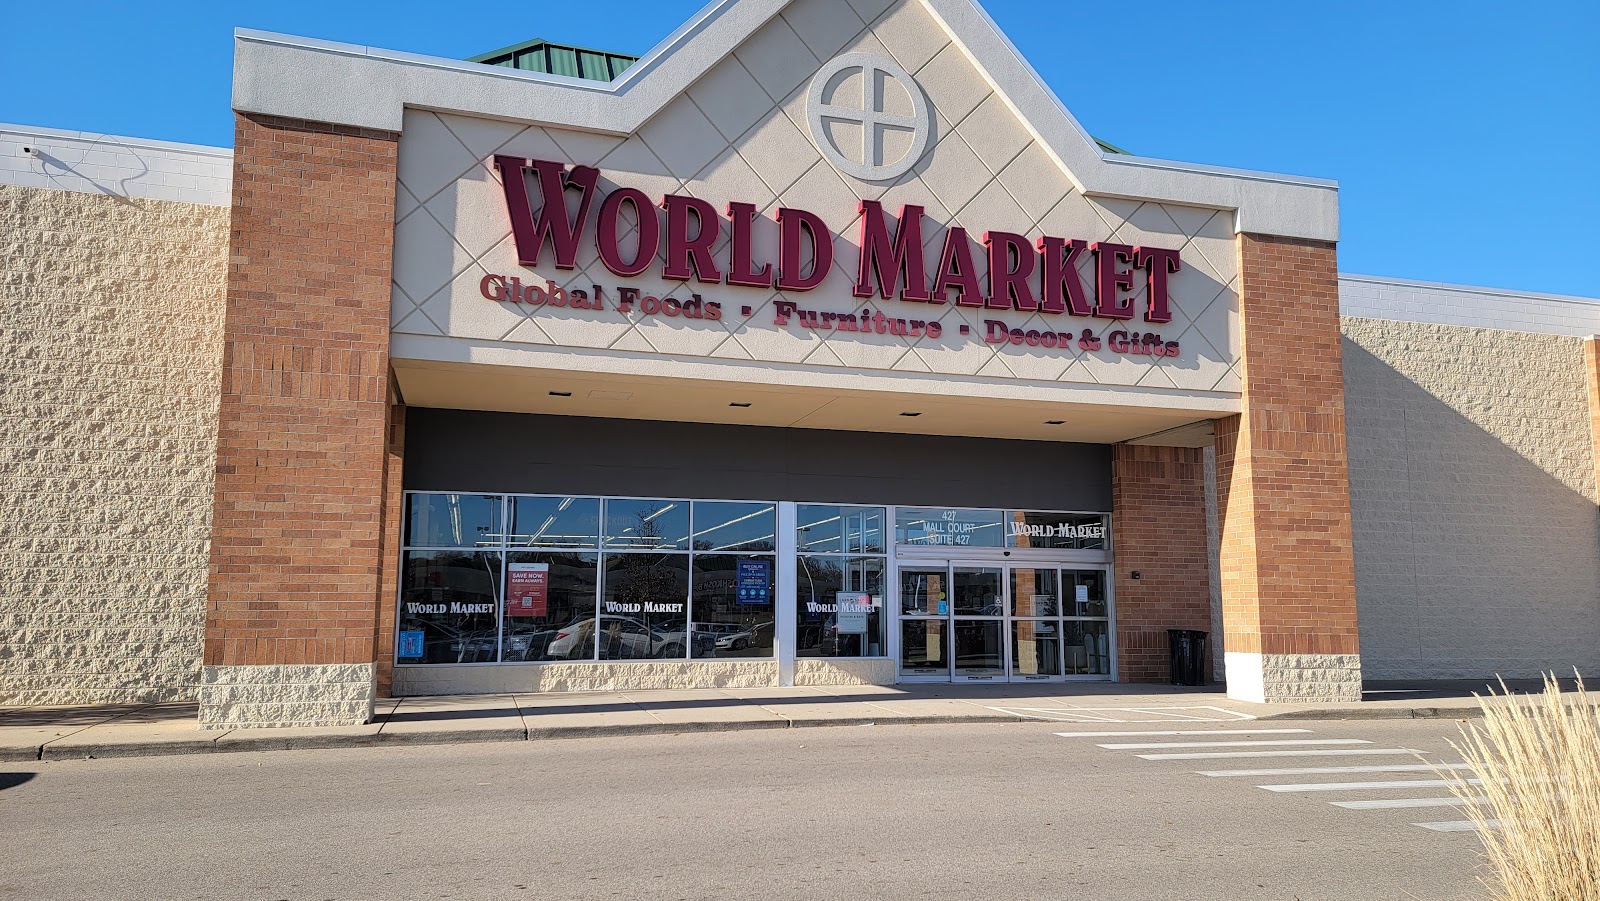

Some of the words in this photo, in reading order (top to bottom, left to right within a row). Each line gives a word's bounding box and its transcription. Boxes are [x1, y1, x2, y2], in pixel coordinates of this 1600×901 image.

[494, 154, 834, 292] WORLD
[853, 200, 1181, 323] MARKET
[479, 273, 604, 311] Global
[616, 286, 722, 321] Foods
[773, 300, 943, 339] Furniture
[984, 318, 1073, 351] Decor
[1078, 328, 1101, 352] &
[1109, 329, 1180, 358] Gifts
[941, 510, 957, 521] 427
[923, 521, 944, 533] MALL
[948, 522, 976, 534] COURT
[1010, 521, 1054, 537] WORLD
[1058, 522, 1106, 539] MARKET
[928, 533, 952, 545] SUITE
[955, 534, 970, 545] 427
[406, 602, 446, 614] WORLD
[450, 601, 494, 614] MARKET
[605, 601, 641, 613] WORLD
[643, 601, 683, 613] MARKET
[806, 602, 838, 613] WORLD
[841, 602, 876, 613] MARKET
